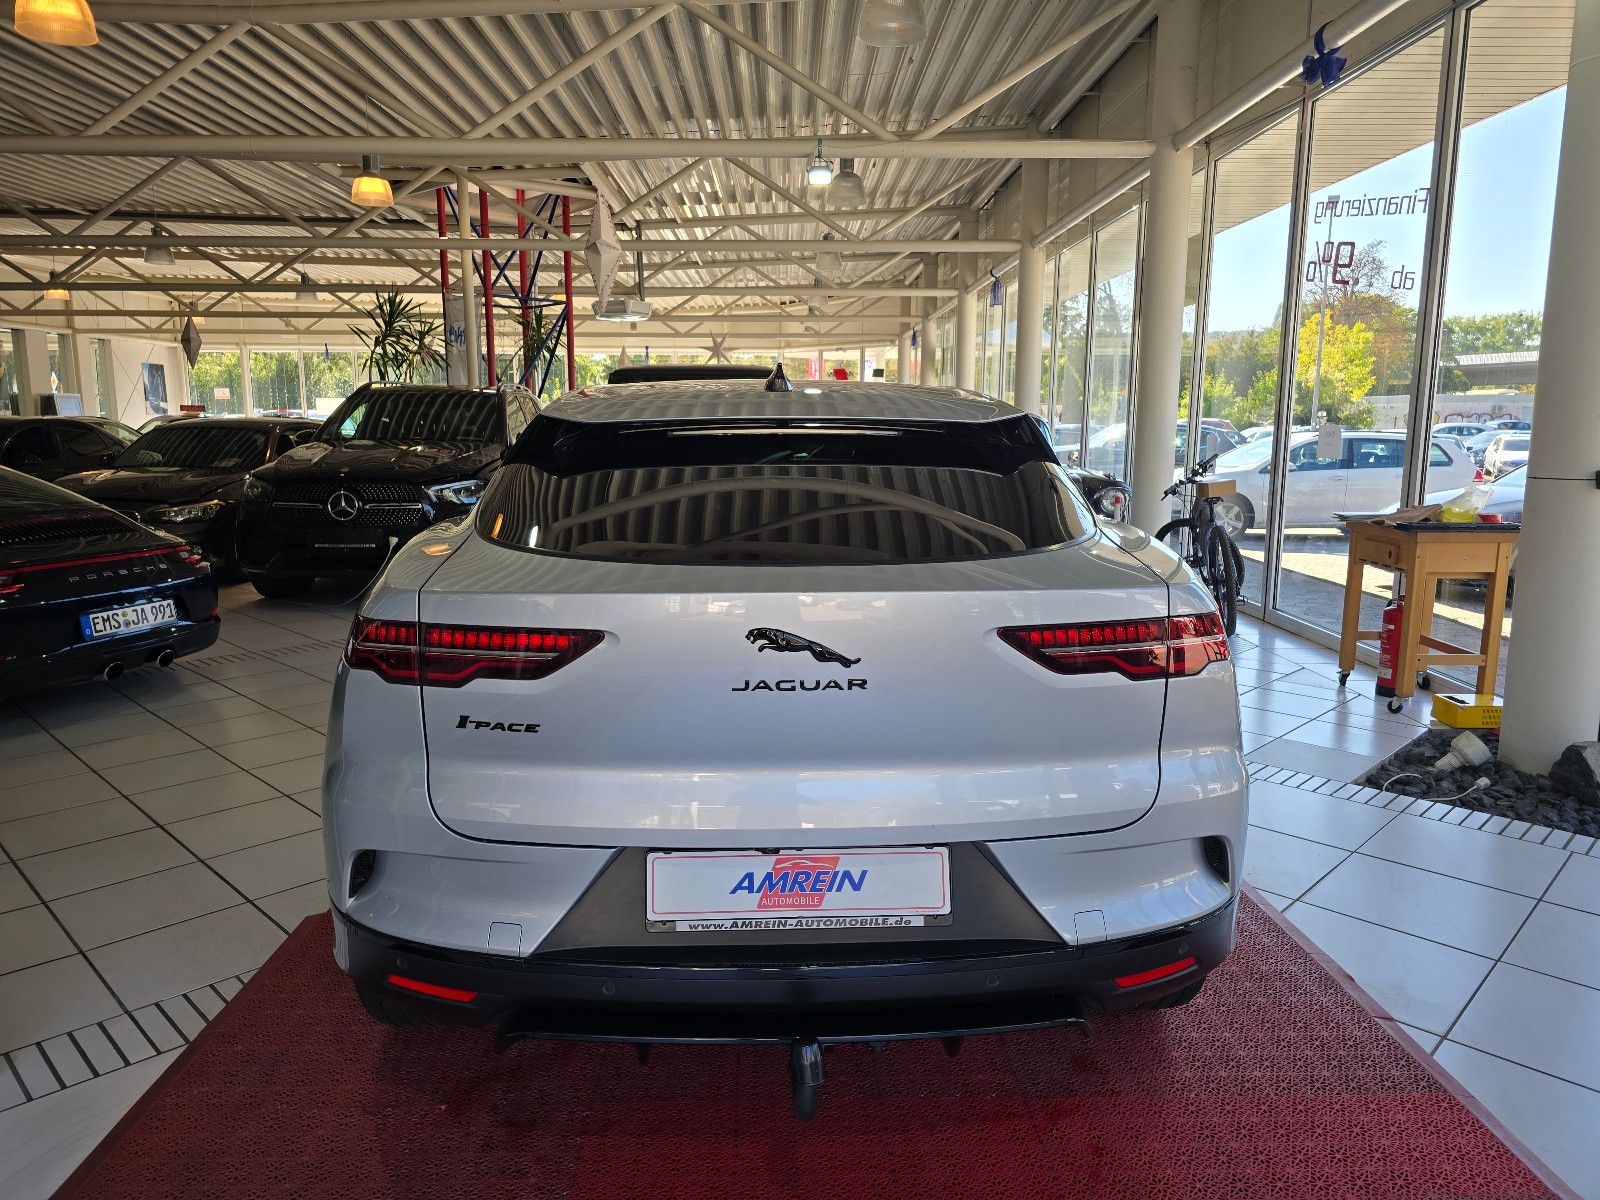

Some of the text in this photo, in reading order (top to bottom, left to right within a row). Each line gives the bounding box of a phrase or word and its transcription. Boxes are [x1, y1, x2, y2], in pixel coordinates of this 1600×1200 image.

[69, 563, 168, 583] PORSCHE
[91, 602, 175, 634] EMS JA 991
[731, 678, 868, 692] JAGUAR
[728, 869, 868, 895] AMREIN
[761, 896, 820, 906] AUTOMOBILE
[688, 917, 912, 930] www.AMREIN-AUTOMOBILE.de
